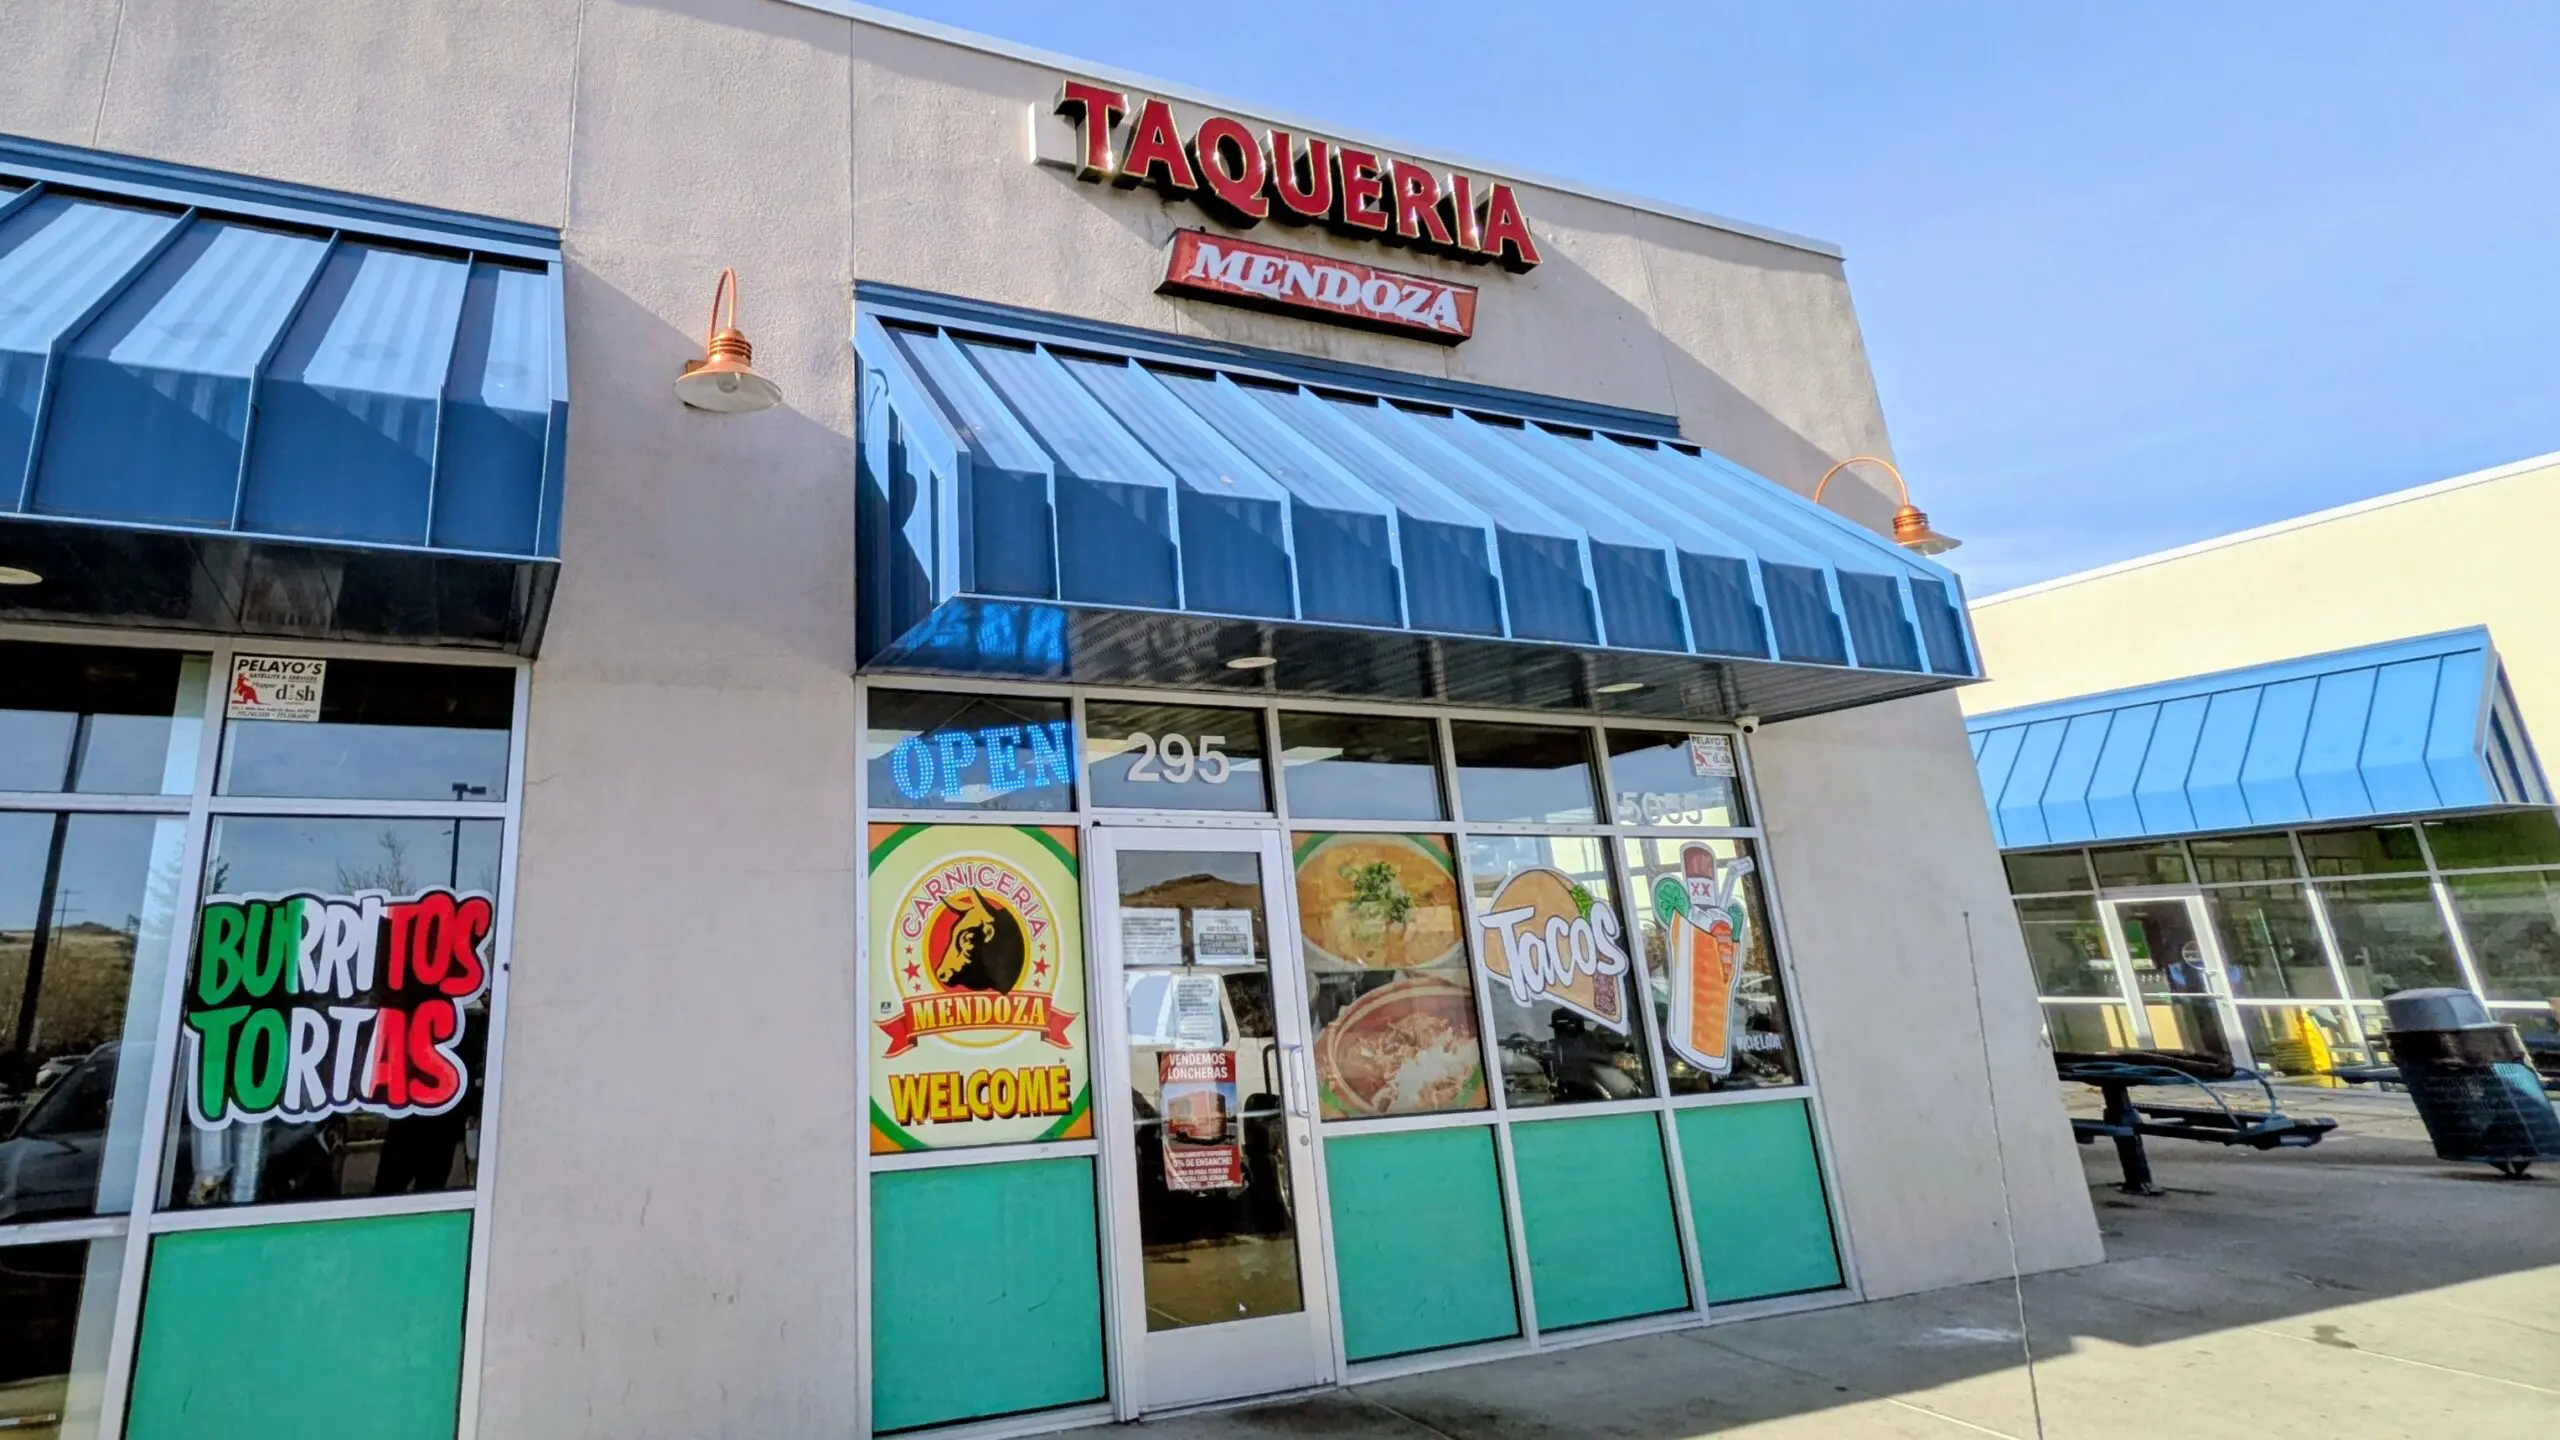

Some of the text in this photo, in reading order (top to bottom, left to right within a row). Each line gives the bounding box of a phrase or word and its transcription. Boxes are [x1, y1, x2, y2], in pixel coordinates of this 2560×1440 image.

[1058, 80, 1542, 268] TAQUERIA
[1188, 241, 1465, 333] MENDOZA
[237, 659, 324, 675] PELAYO'S
[275, 684, 315, 702] dish
[891, 721, 1071, 800] OPEN
[1126, 731, 1231, 784] 295
[901, 863, 1049, 941] CARNICERIA
[198, 893, 491, 1005] BURRITOS
[1478, 901, 1628, 1002] Tacos
[910, 995, 1047, 1031] MENDOZA
[189, 999, 460, 1118] TORTAS
[1167, 1066, 1229, 1080] LONCHERAS
[1169, 1052, 1226, 1066] VENDEMOS
[888, 1065, 1073, 1126] WELCOME
[1186, 1158, 1195, 1167] DE
